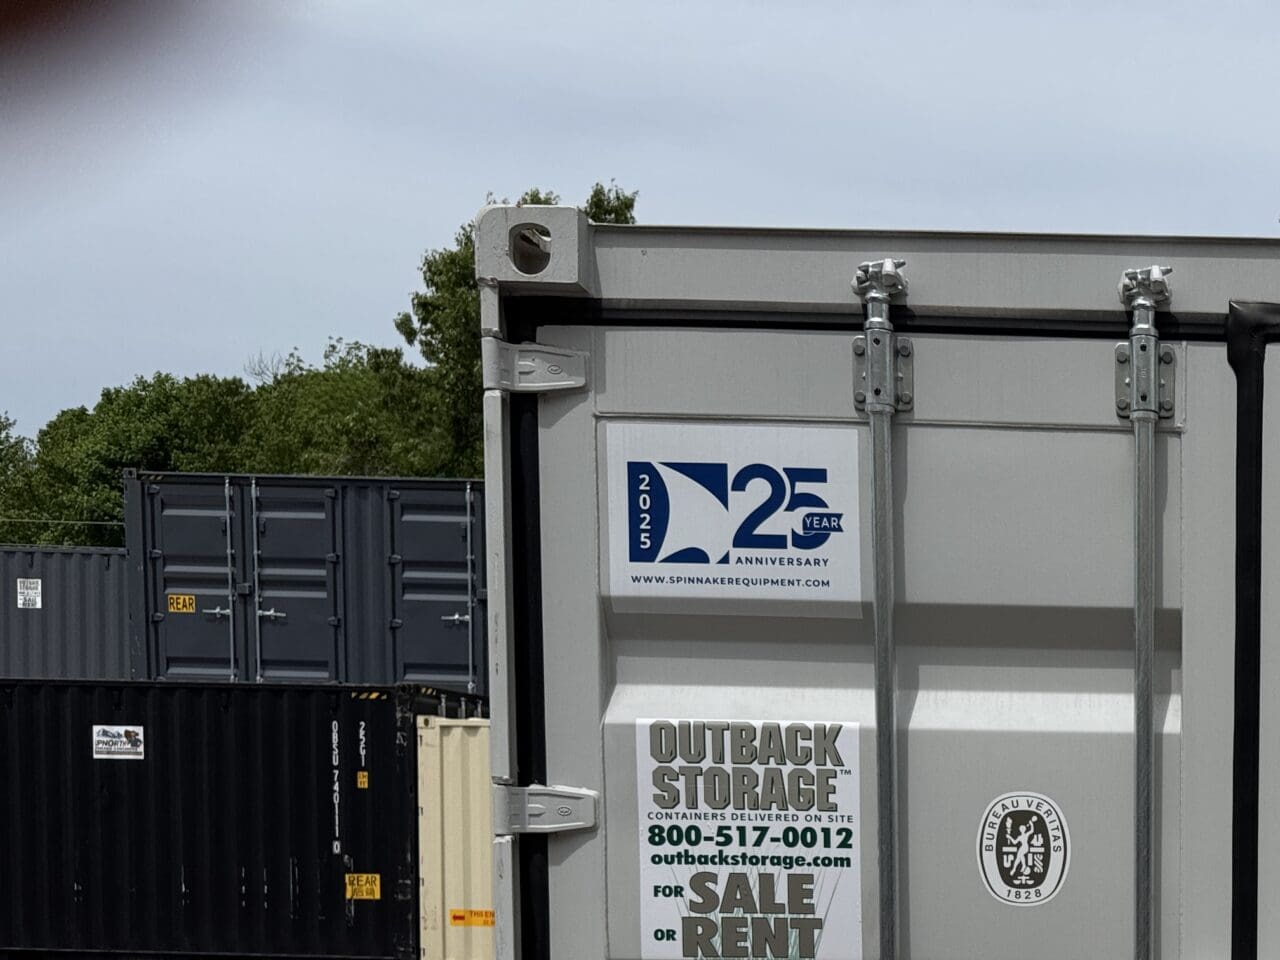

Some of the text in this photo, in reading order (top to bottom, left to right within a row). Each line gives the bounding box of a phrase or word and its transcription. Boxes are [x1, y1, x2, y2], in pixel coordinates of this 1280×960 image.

[638, 474, 651, 549] 2025
[731, 463, 831, 550] 25
[804, 516, 839, 529] YEAR
[735, 556, 829, 567] ANNIVERSARY
[631, 575, 830, 588] WWW.SPINNAKEREQUIPMENT.COM
[169, 596, 194, 611] REAR
[649, 720, 845, 767] OUTBACK
[651, 765, 839, 812] STORAGE
[647, 811, 854, 823] CONTAINERS DELIVERED ON SITE
[985, 799, 1062, 853] BUREAU VERITAS
[648, 825, 853, 849] 800-517-0012
[650, 850, 852, 869] outbackstorage.com
[348, 875, 377, 886] REAR
[653, 871, 815, 915] FOR SALE
[1006, 889, 1042, 900] 1828
[653, 916, 823, 959] OR RENT
